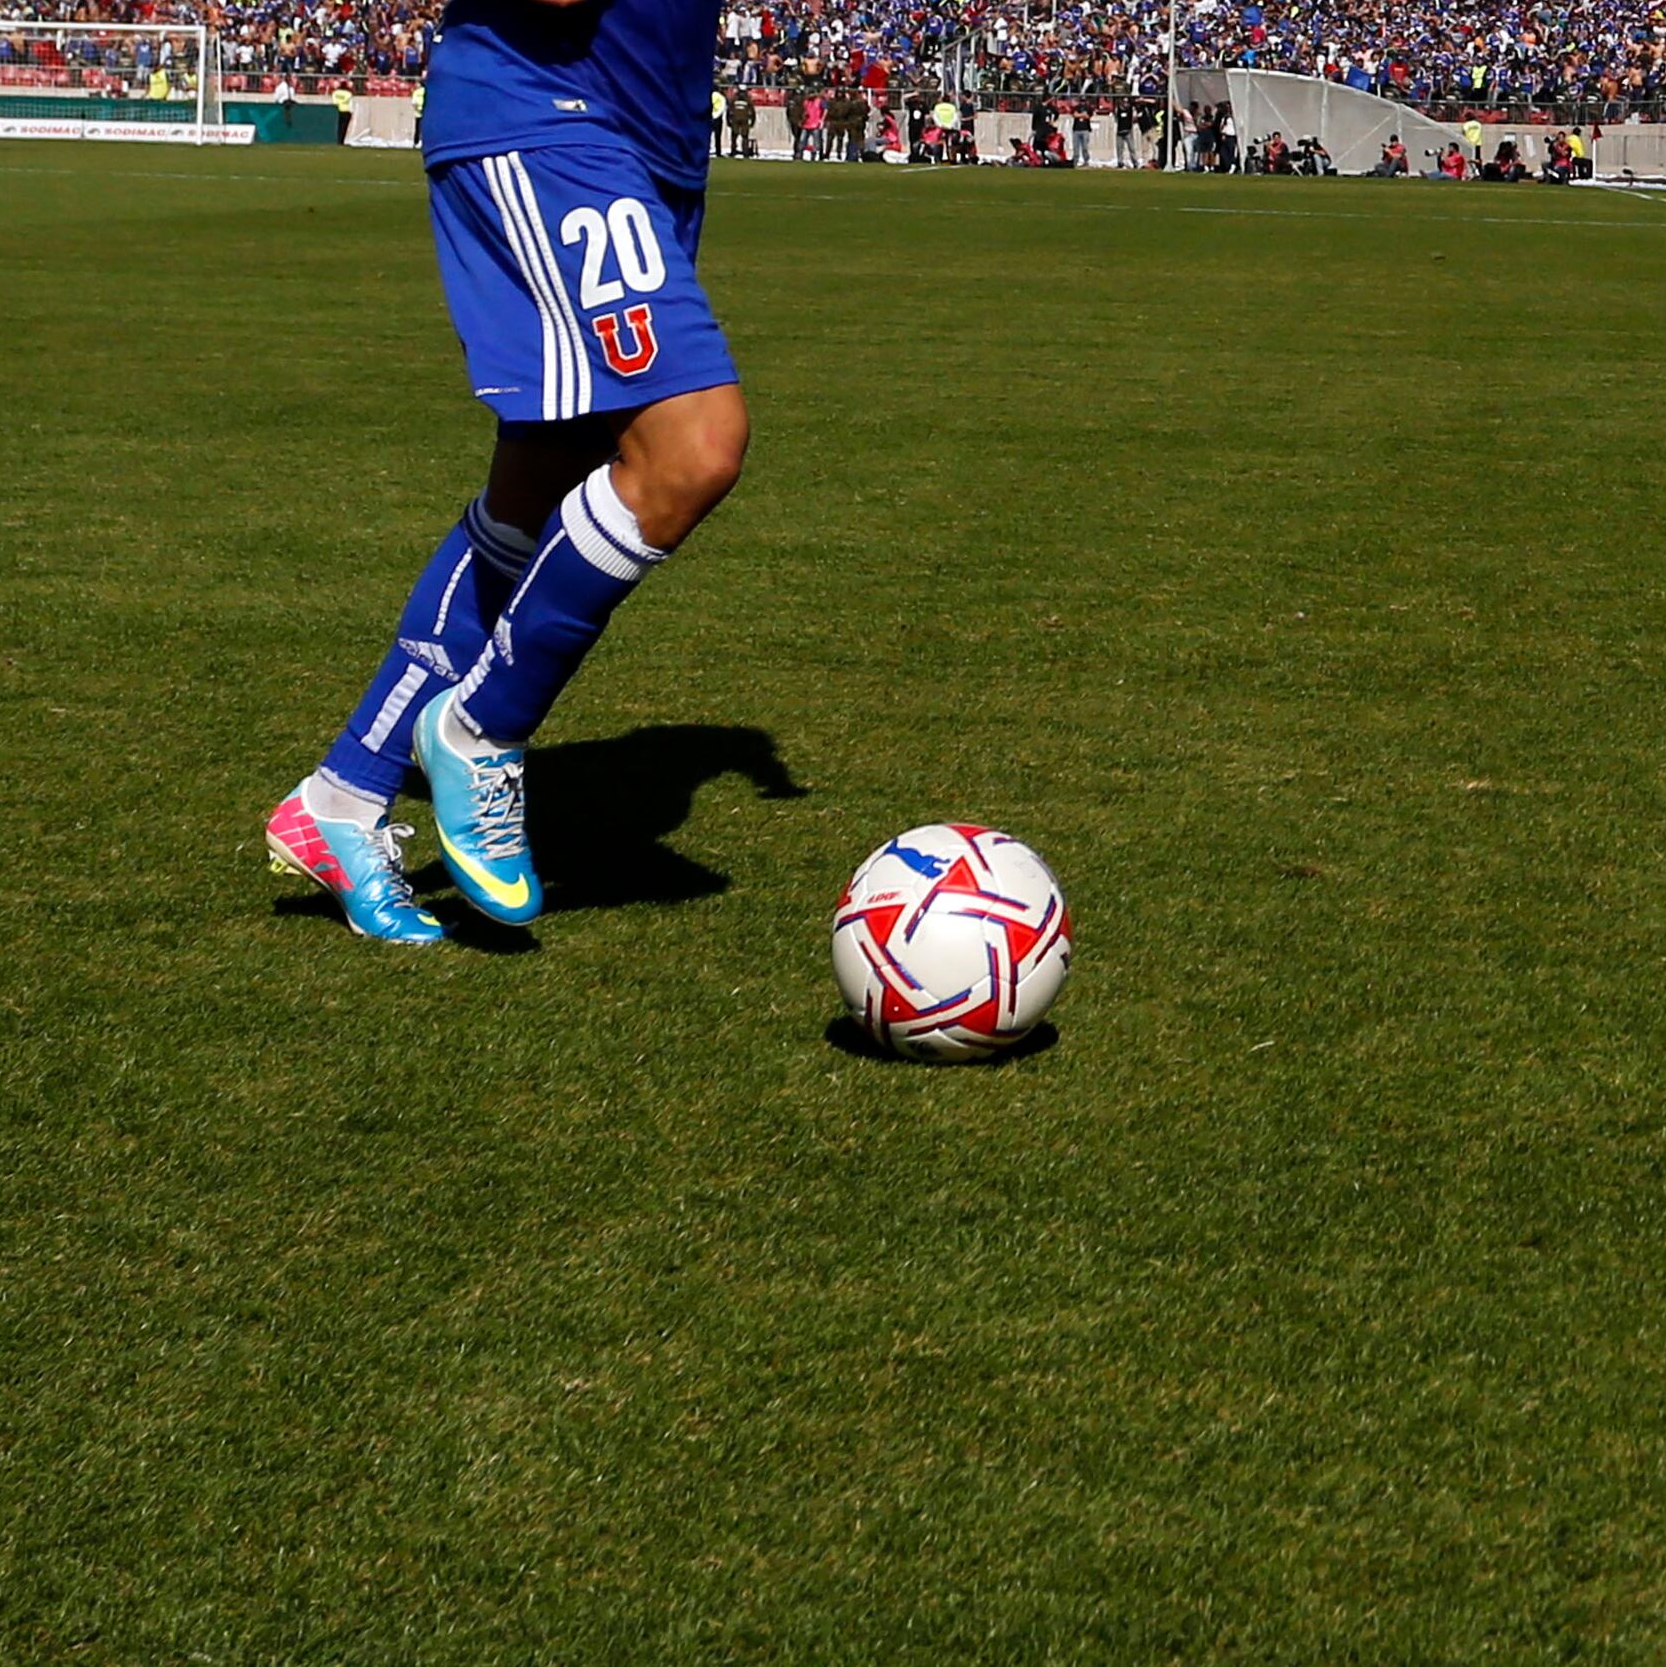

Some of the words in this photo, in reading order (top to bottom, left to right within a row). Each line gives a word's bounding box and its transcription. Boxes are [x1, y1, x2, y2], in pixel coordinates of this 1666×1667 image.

[20, 126, 82, 134] SODIMAC
[560, 197, 666, 310] 20
[593, 303, 659, 376] U
